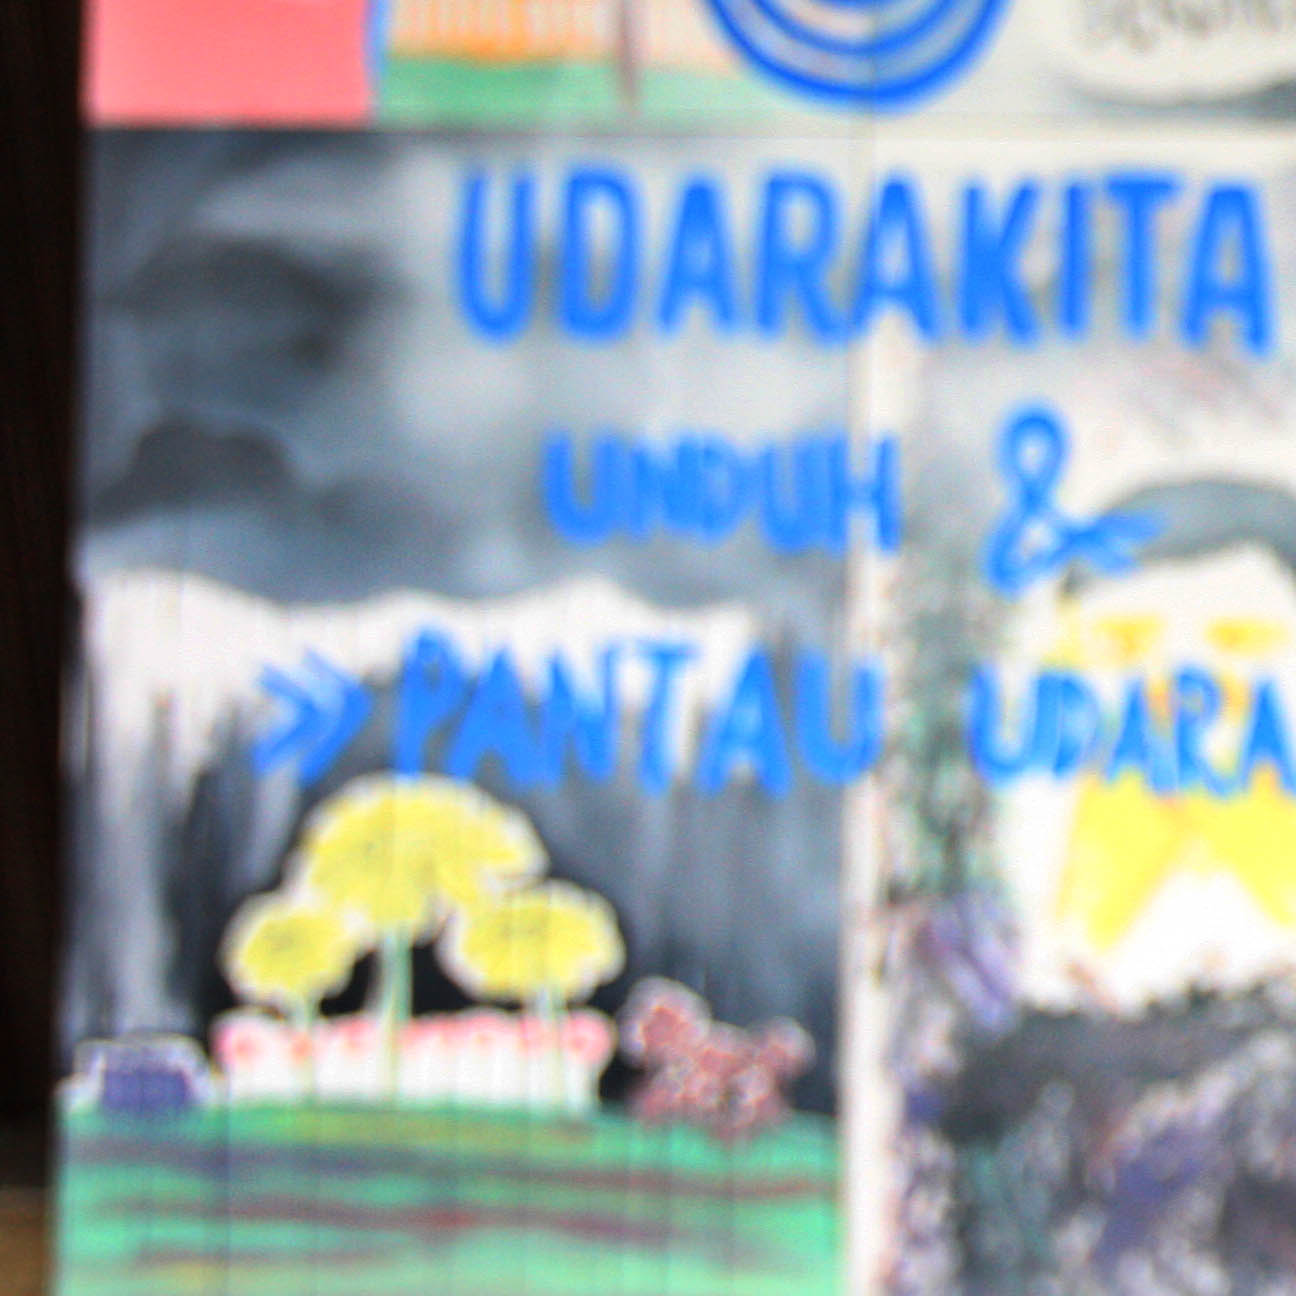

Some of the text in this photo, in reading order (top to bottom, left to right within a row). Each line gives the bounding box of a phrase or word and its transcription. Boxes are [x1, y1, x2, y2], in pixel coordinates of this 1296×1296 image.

[452, 164, 1281, 360] UDARAKITA
[541, 432, 902, 554] UNDUH
[385, 629, 885, 796] PANTAU
